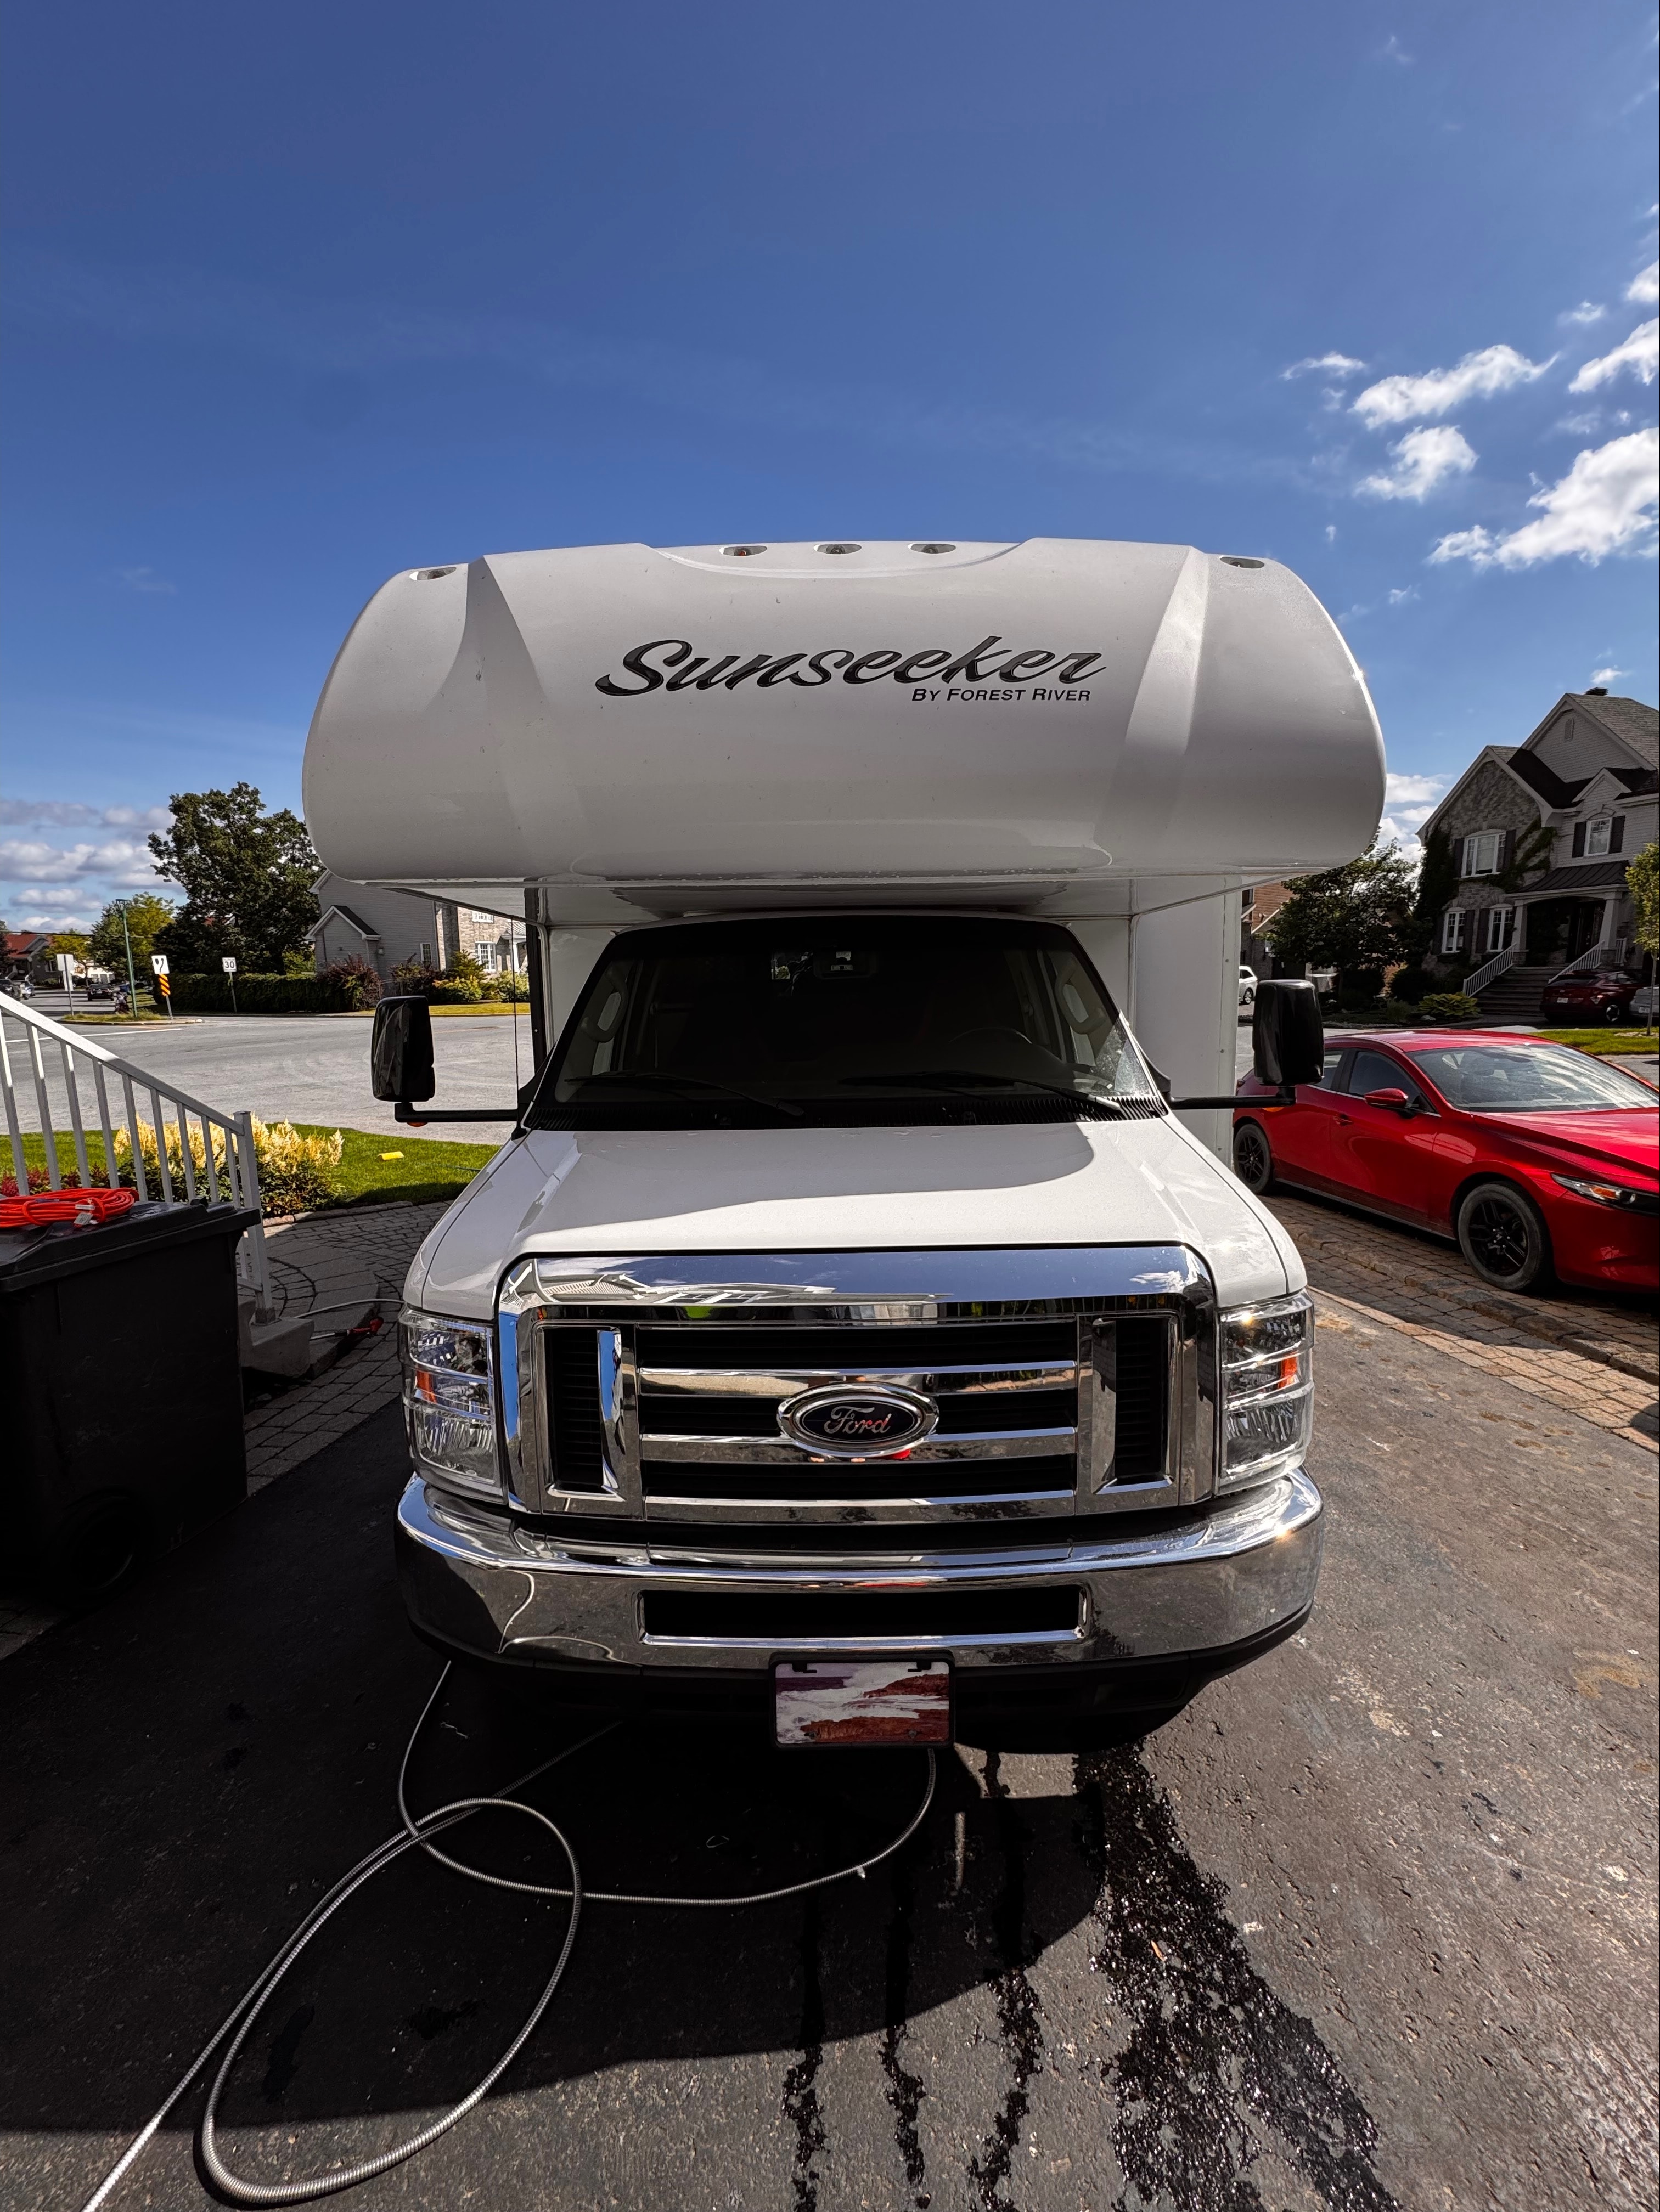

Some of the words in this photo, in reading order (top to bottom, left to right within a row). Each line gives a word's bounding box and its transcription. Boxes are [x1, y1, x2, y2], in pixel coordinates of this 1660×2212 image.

[595, 635, 1107, 697] Sunseeker
[947, 688, 1026, 701] FOREST
[1032, 688, 1091, 701] RIVER
[824, 1406, 892, 1434] Ford
